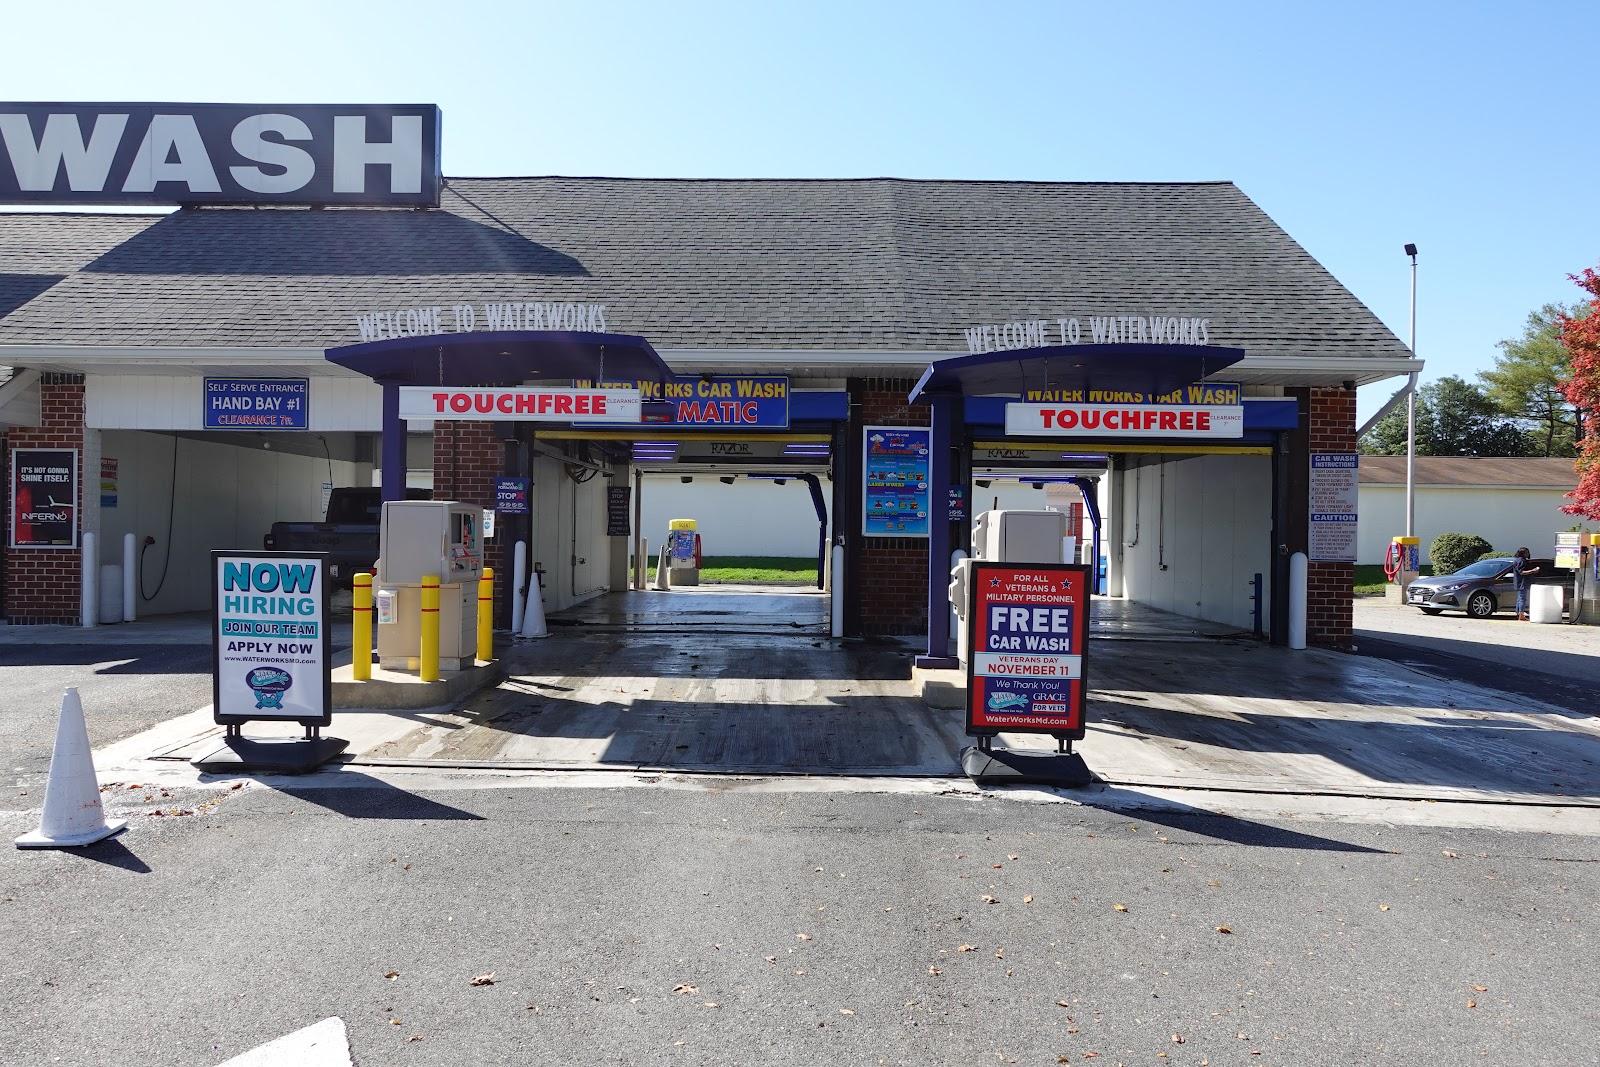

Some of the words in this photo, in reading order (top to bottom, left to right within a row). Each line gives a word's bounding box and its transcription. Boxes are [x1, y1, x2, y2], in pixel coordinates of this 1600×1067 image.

[0, 113, 422, 194] WASH
[356, 306, 443, 342] WELCOME
[453, 304, 475, 332] TO
[485, 302, 606, 333] WATERWORKS
[964, 320, 1049, 355] WELCOME
[1058, 318, 1080, 346] TO
[1089, 316, 1210, 346] WATERWORKS
[697, 380, 732, 397] CAR
[736, 380, 786, 398] WASH
[1187, 386, 1237, 405] WASH
[212, 397, 252, 410] HAND
[256, 397, 282, 410] BAY
[287, 398, 300, 410] #1
[433, 393, 607, 415] TOUCHFREE
[677, 401, 758, 424] MATIC
[218, 415, 277, 425] CLEARANCE
[1040, 409, 1211, 431] TOUCHFREE
[711, 442, 750, 454] RAZOR
[21, 466, 33, 474] IT'S
[497, 492, 517, 500] STOP
[22, 511, 67, 521] INFERNO
[223, 562, 316, 594] NOW
[1014, 574, 1031, 582] FOR
[1033, 575, 1049, 583] ALL
[1005, 584, 1049, 593] VETERANS
[1051, 585, 1057, 593] &
[986, 593, 1024, 601] MILITARY
[1026, 595, 1075, 603] PERSONNEL
[224, 596, 315, 616] HIRING
[991, 606, 1069, 633] FREE
[225, 622, 252, 633] JOIN
[255, 623, 279, 634] OUR
[282, 624, 315, 635] TEAM
[227, 641, 273, 654] APPLY
[277, 643, 313, 654] NOW
[989, 634, 1020, 650] CAR
[1025, 635, 1070, 651] WASH
[224, 656, 316, 664] www.WATERWORKSMD.com
[999, 655, 1041, 663] VETERANS
[988, 664, 1056, 675] NOVEMBER
[1059, 666, 1069, 676] 11
[996, 680, 1011, 688] We
[1013, 680, 1038, 689] Thank
[1040, 681, 1060, 690] You!
[1032, 692, 1066, 701] GRACE
[986, 715, 1068, 725] WaterWorksMd.com
